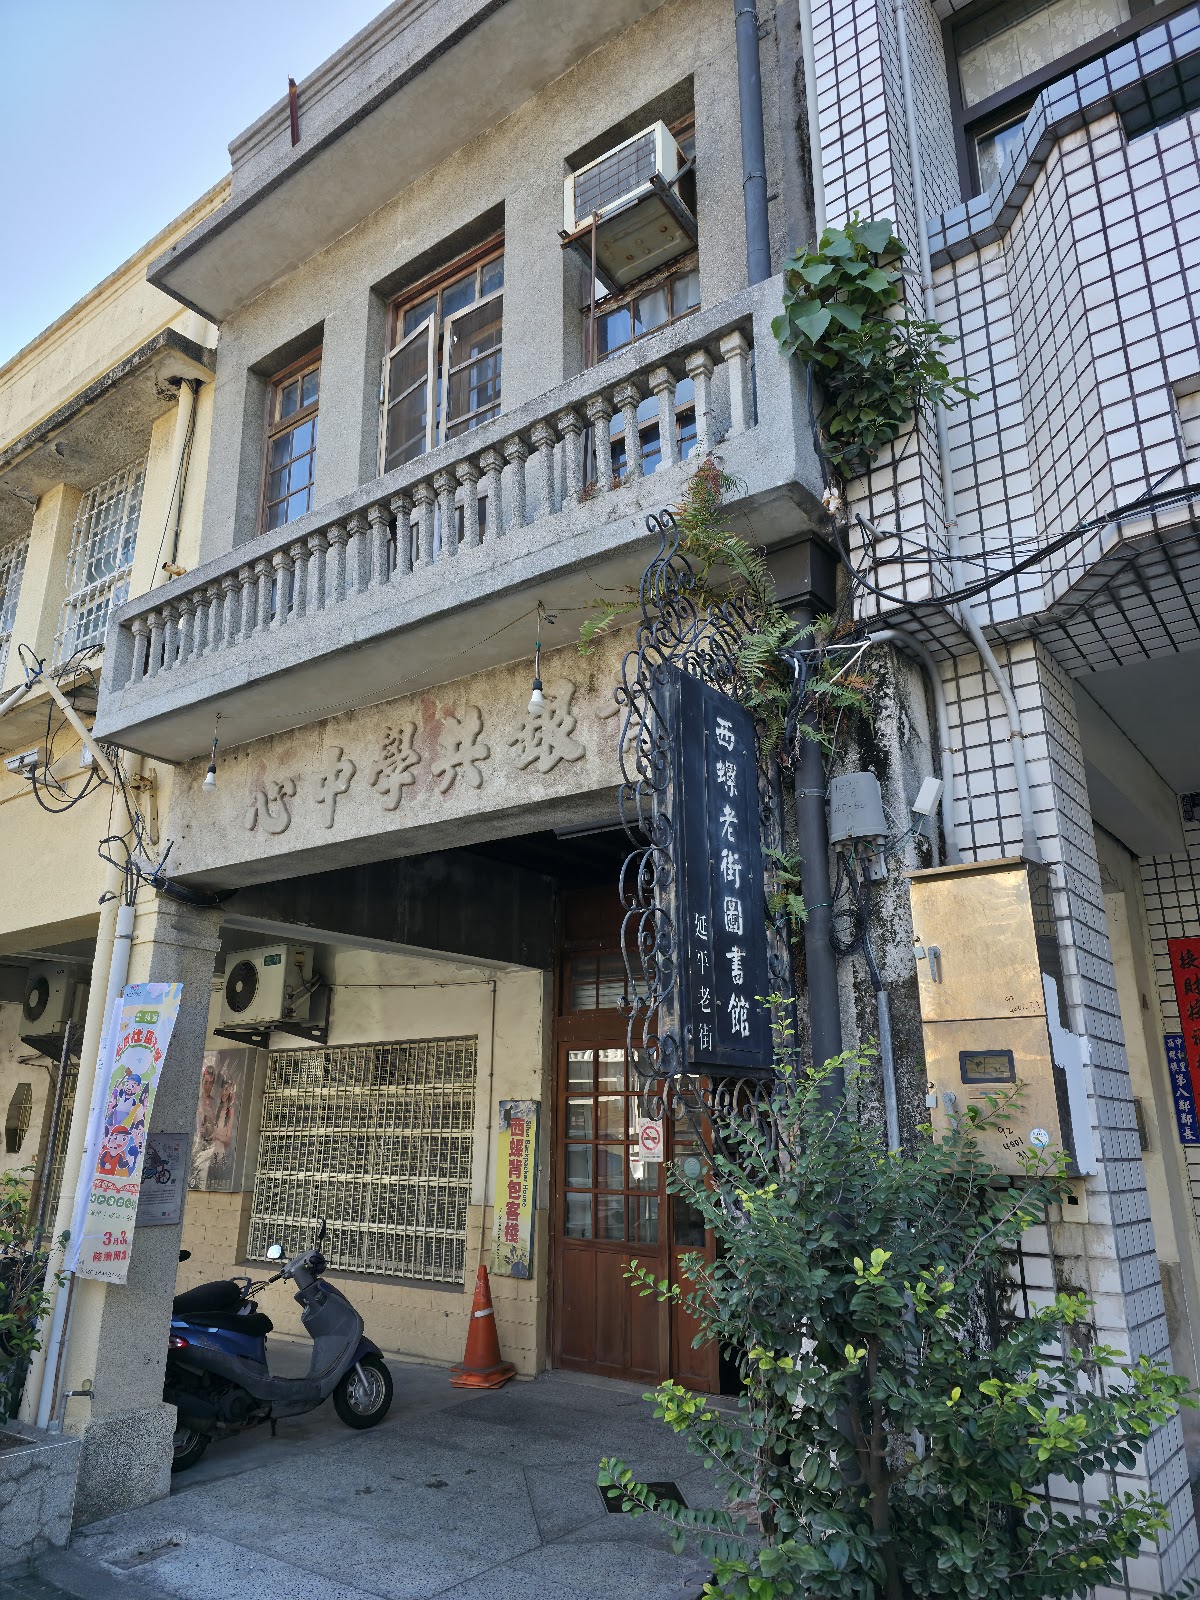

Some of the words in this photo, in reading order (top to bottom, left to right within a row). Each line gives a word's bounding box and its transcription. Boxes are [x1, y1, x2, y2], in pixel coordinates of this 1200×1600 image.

[715, 716, 750, 1038] 西螺老街圖書館
[694, 912, 713, 1052] 延平老街
[504, 1117, 526, 1244] 西螺背包客棧
[521, 1184, 529, 1208] House
[523, 1140, 531, 1183] Backpacker
